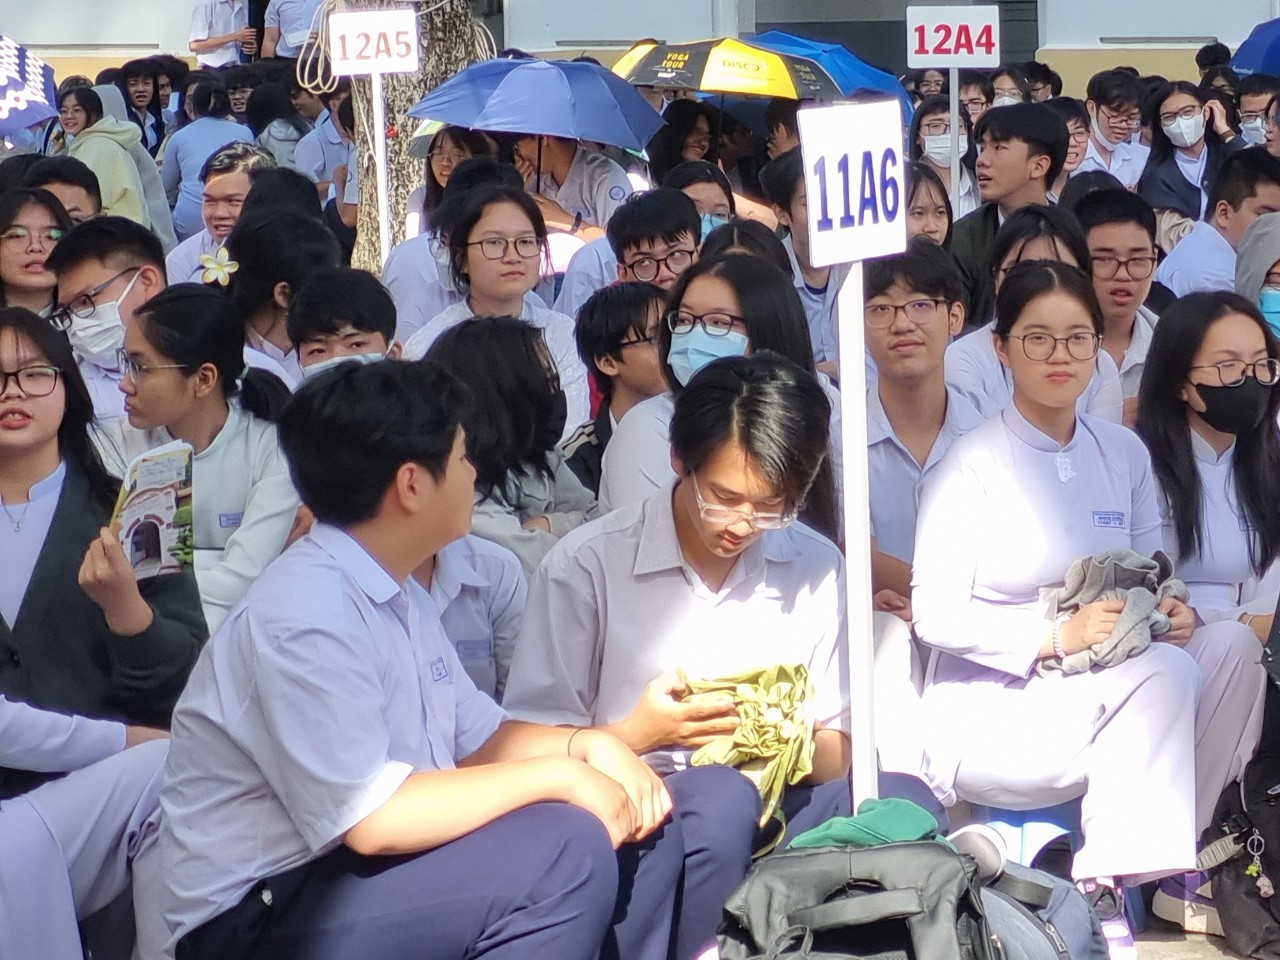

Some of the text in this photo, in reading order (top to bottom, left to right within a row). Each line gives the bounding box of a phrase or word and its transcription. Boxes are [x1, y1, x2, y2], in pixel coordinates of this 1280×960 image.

[338, 30, 412, 61] 12A5
[913, 24, 996, 55] 12A4
[813, 147, 900, 233] 11A6
